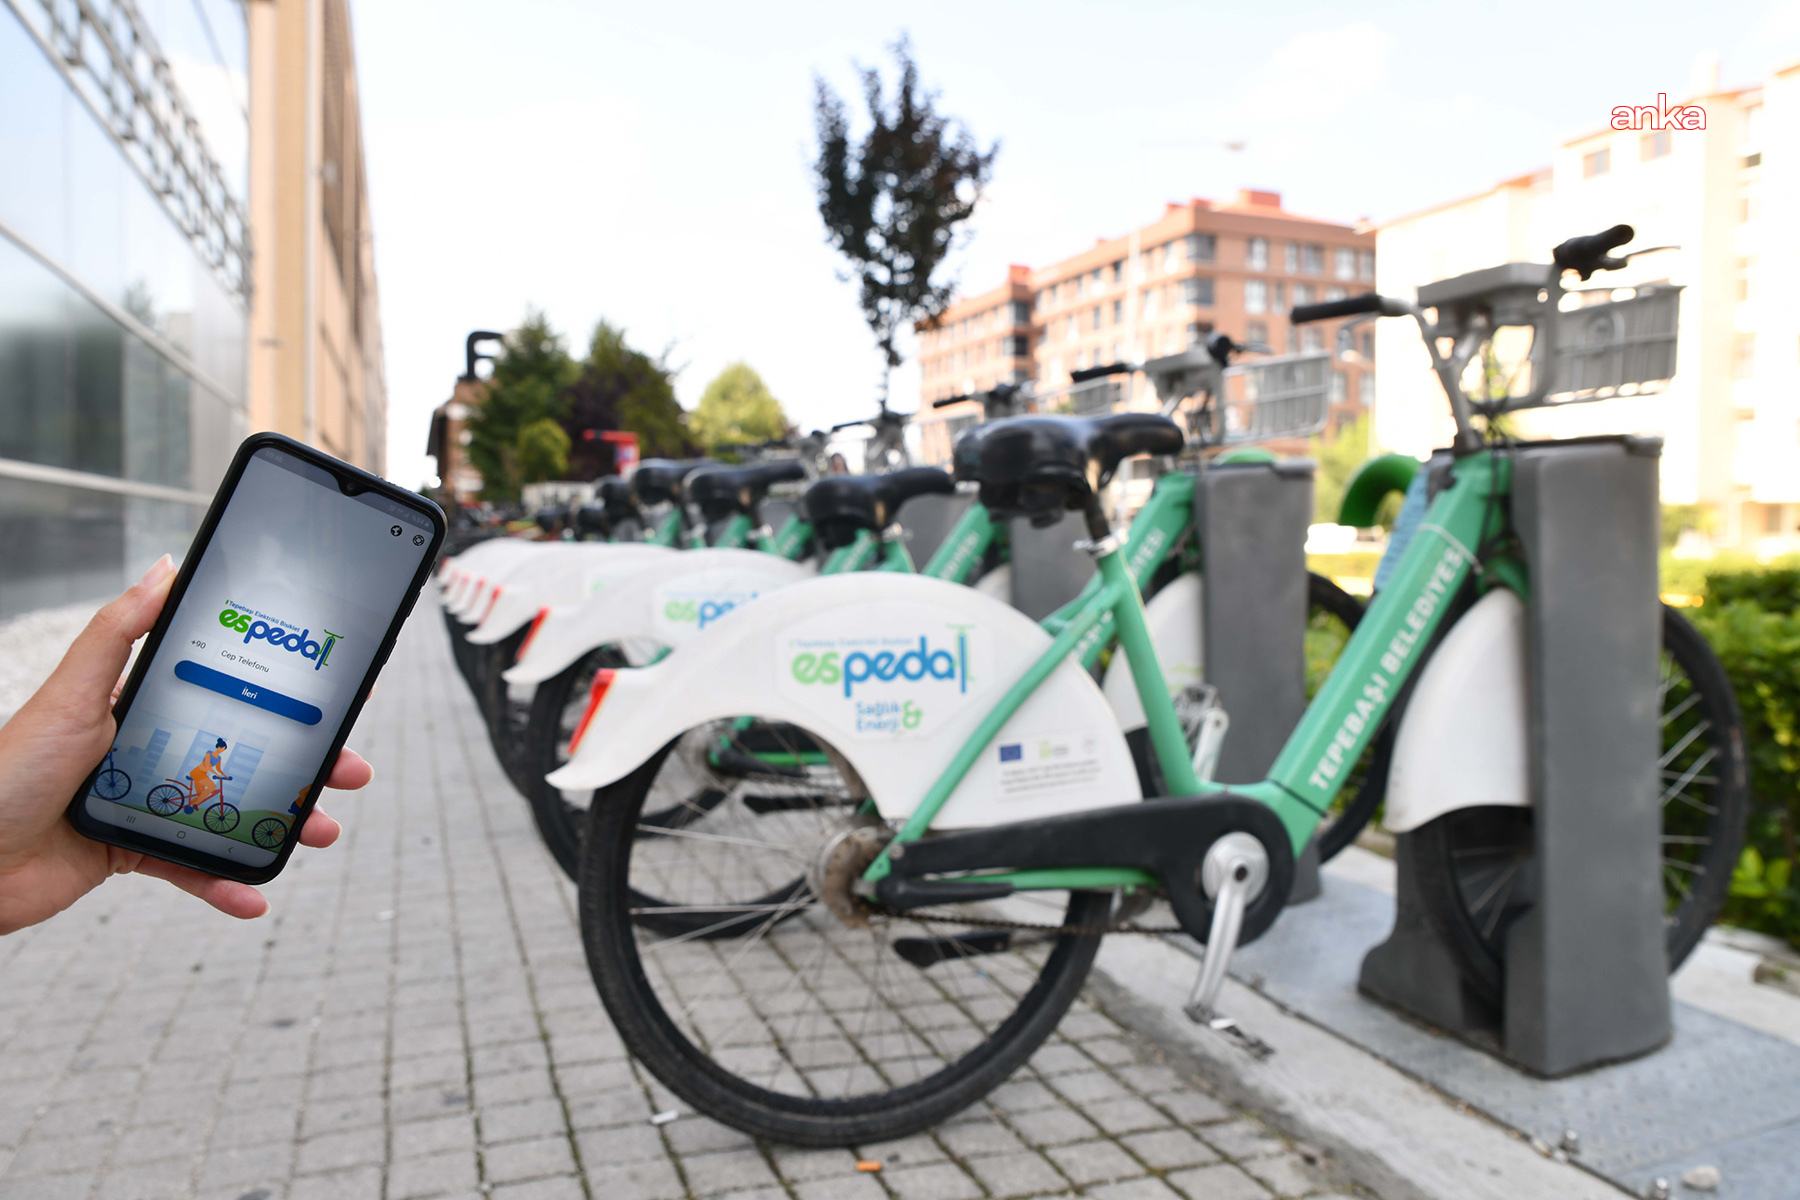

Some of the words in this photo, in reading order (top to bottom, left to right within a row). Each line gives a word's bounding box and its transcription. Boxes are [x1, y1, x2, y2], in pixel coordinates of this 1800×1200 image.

[219, 609, 334, 671] espedal
[229, 600, 254, 615] Tepebaşı
[254, 610, 280, 624] Elektrikli
[279, 620, 301, 633] Bisiklet
[191, 639, 207, 650] +90
[221, 650, 236, 661] Cep
[238, 656, 270, 673] Telefonu
[791, 633, 967, 698] espedal
[1308, 673, 1390, 790] TEPEBAŞI
[1379, 546, 1465, 675] BELEDİYES
[241, 686, 258, 700] İleri
